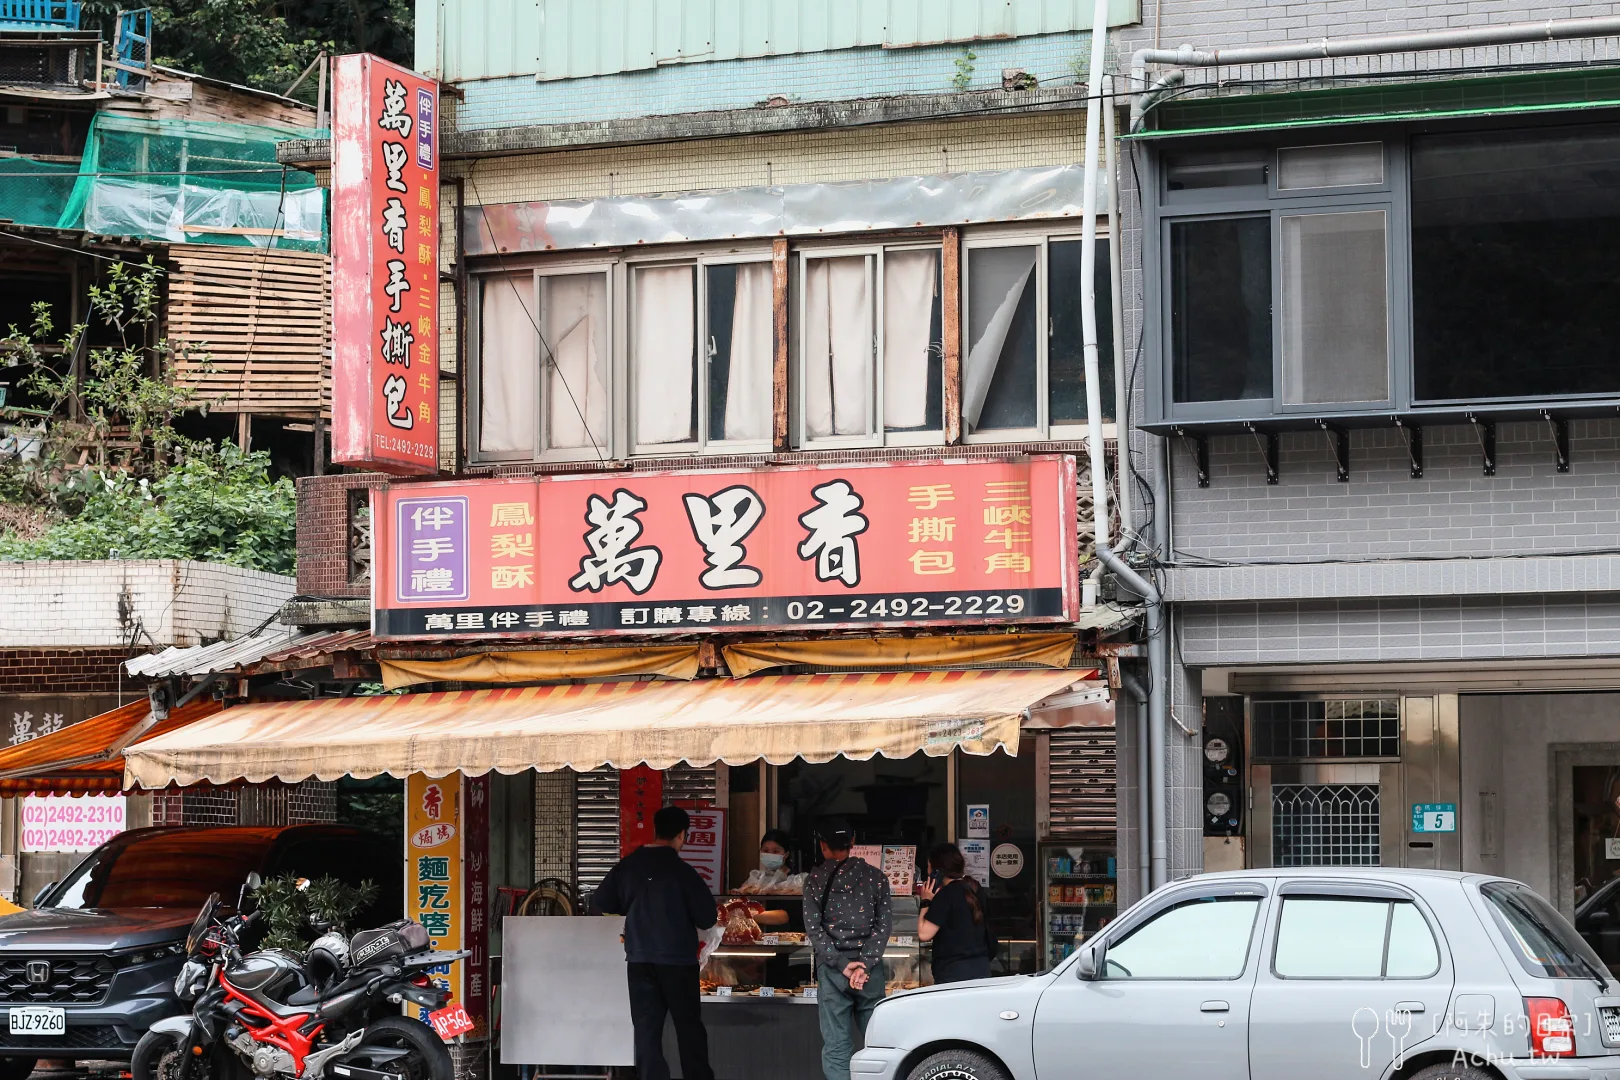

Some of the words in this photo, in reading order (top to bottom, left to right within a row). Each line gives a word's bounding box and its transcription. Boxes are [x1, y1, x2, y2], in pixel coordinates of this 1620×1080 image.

[418, 95, 432, 164] 伴手禮
[378, 79, 415, 430] 萬里香手撕包
[410, 506, 455, 593] 伴手禮
[489, 502, 535, 589] 鳳梨酥
[568, 479, 869, 595] 萬里香
[907, 484, 956, 576] 手撕包
[982, 481, 1032, 574] 三峽牛角
[424, 610, 590, 631] 萬里伴手禮
[786, 594, 1025, 620] 02-2492-2229
[21, 806, 123, 827] (02)2492-2310
[21, 829, 122, 850] (02)2492-232
[423, 784, 443, 820] 香
[1434, 813, 1444, 829] 5
